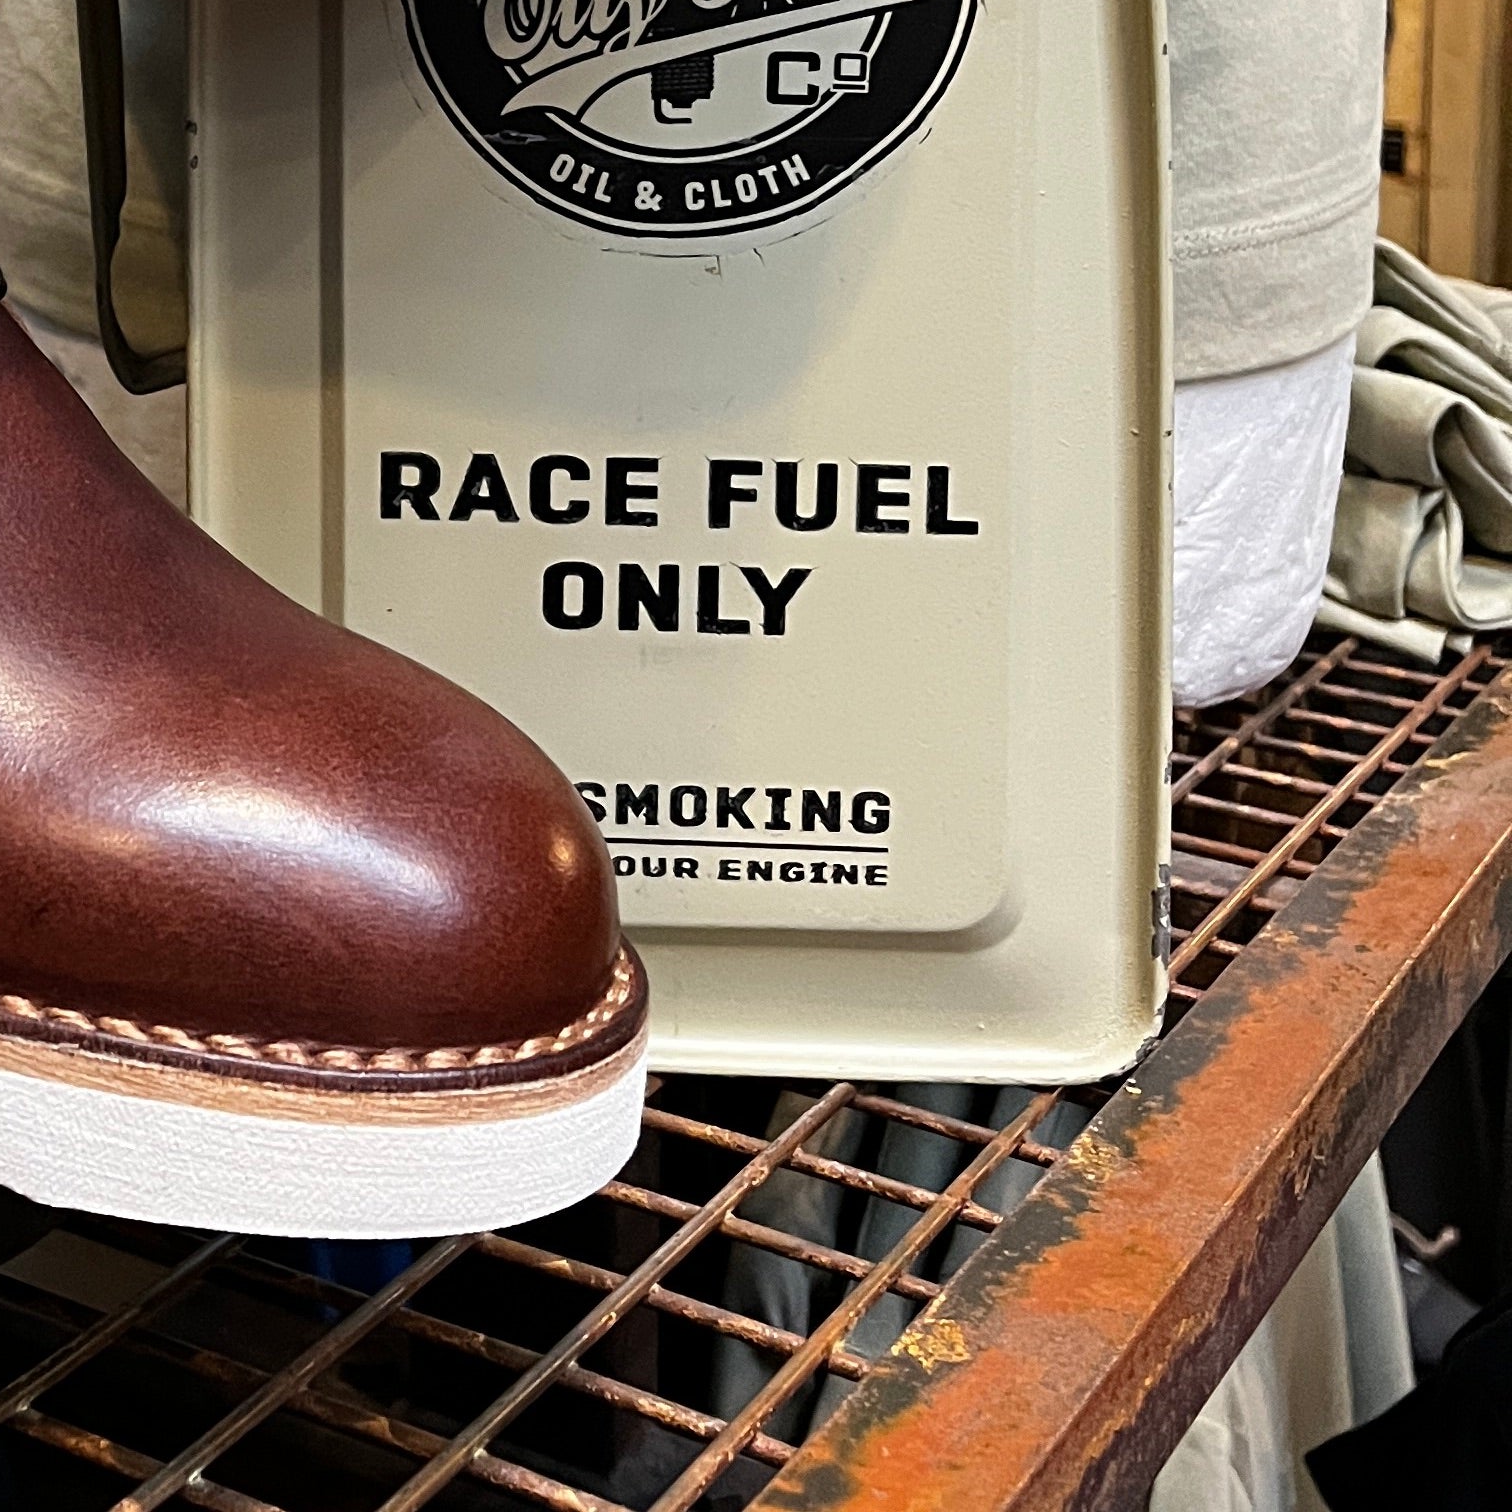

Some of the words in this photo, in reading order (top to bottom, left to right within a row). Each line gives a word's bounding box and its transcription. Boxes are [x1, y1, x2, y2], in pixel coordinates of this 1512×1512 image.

[550, 153, 612, 205] OIL
[634, 179, 663, 212] &
[684, 153, 812, 212] CLOTH
[380, 451, 660, 527] RACE
[706, 458, 980, 536] FUEL
[541, 560, 813, 636] ONLY
[575, 782, 891, 835] SMOKING
[612, 854, 700, 879] OUR
[717, 859, 888, 886] ENGINE
